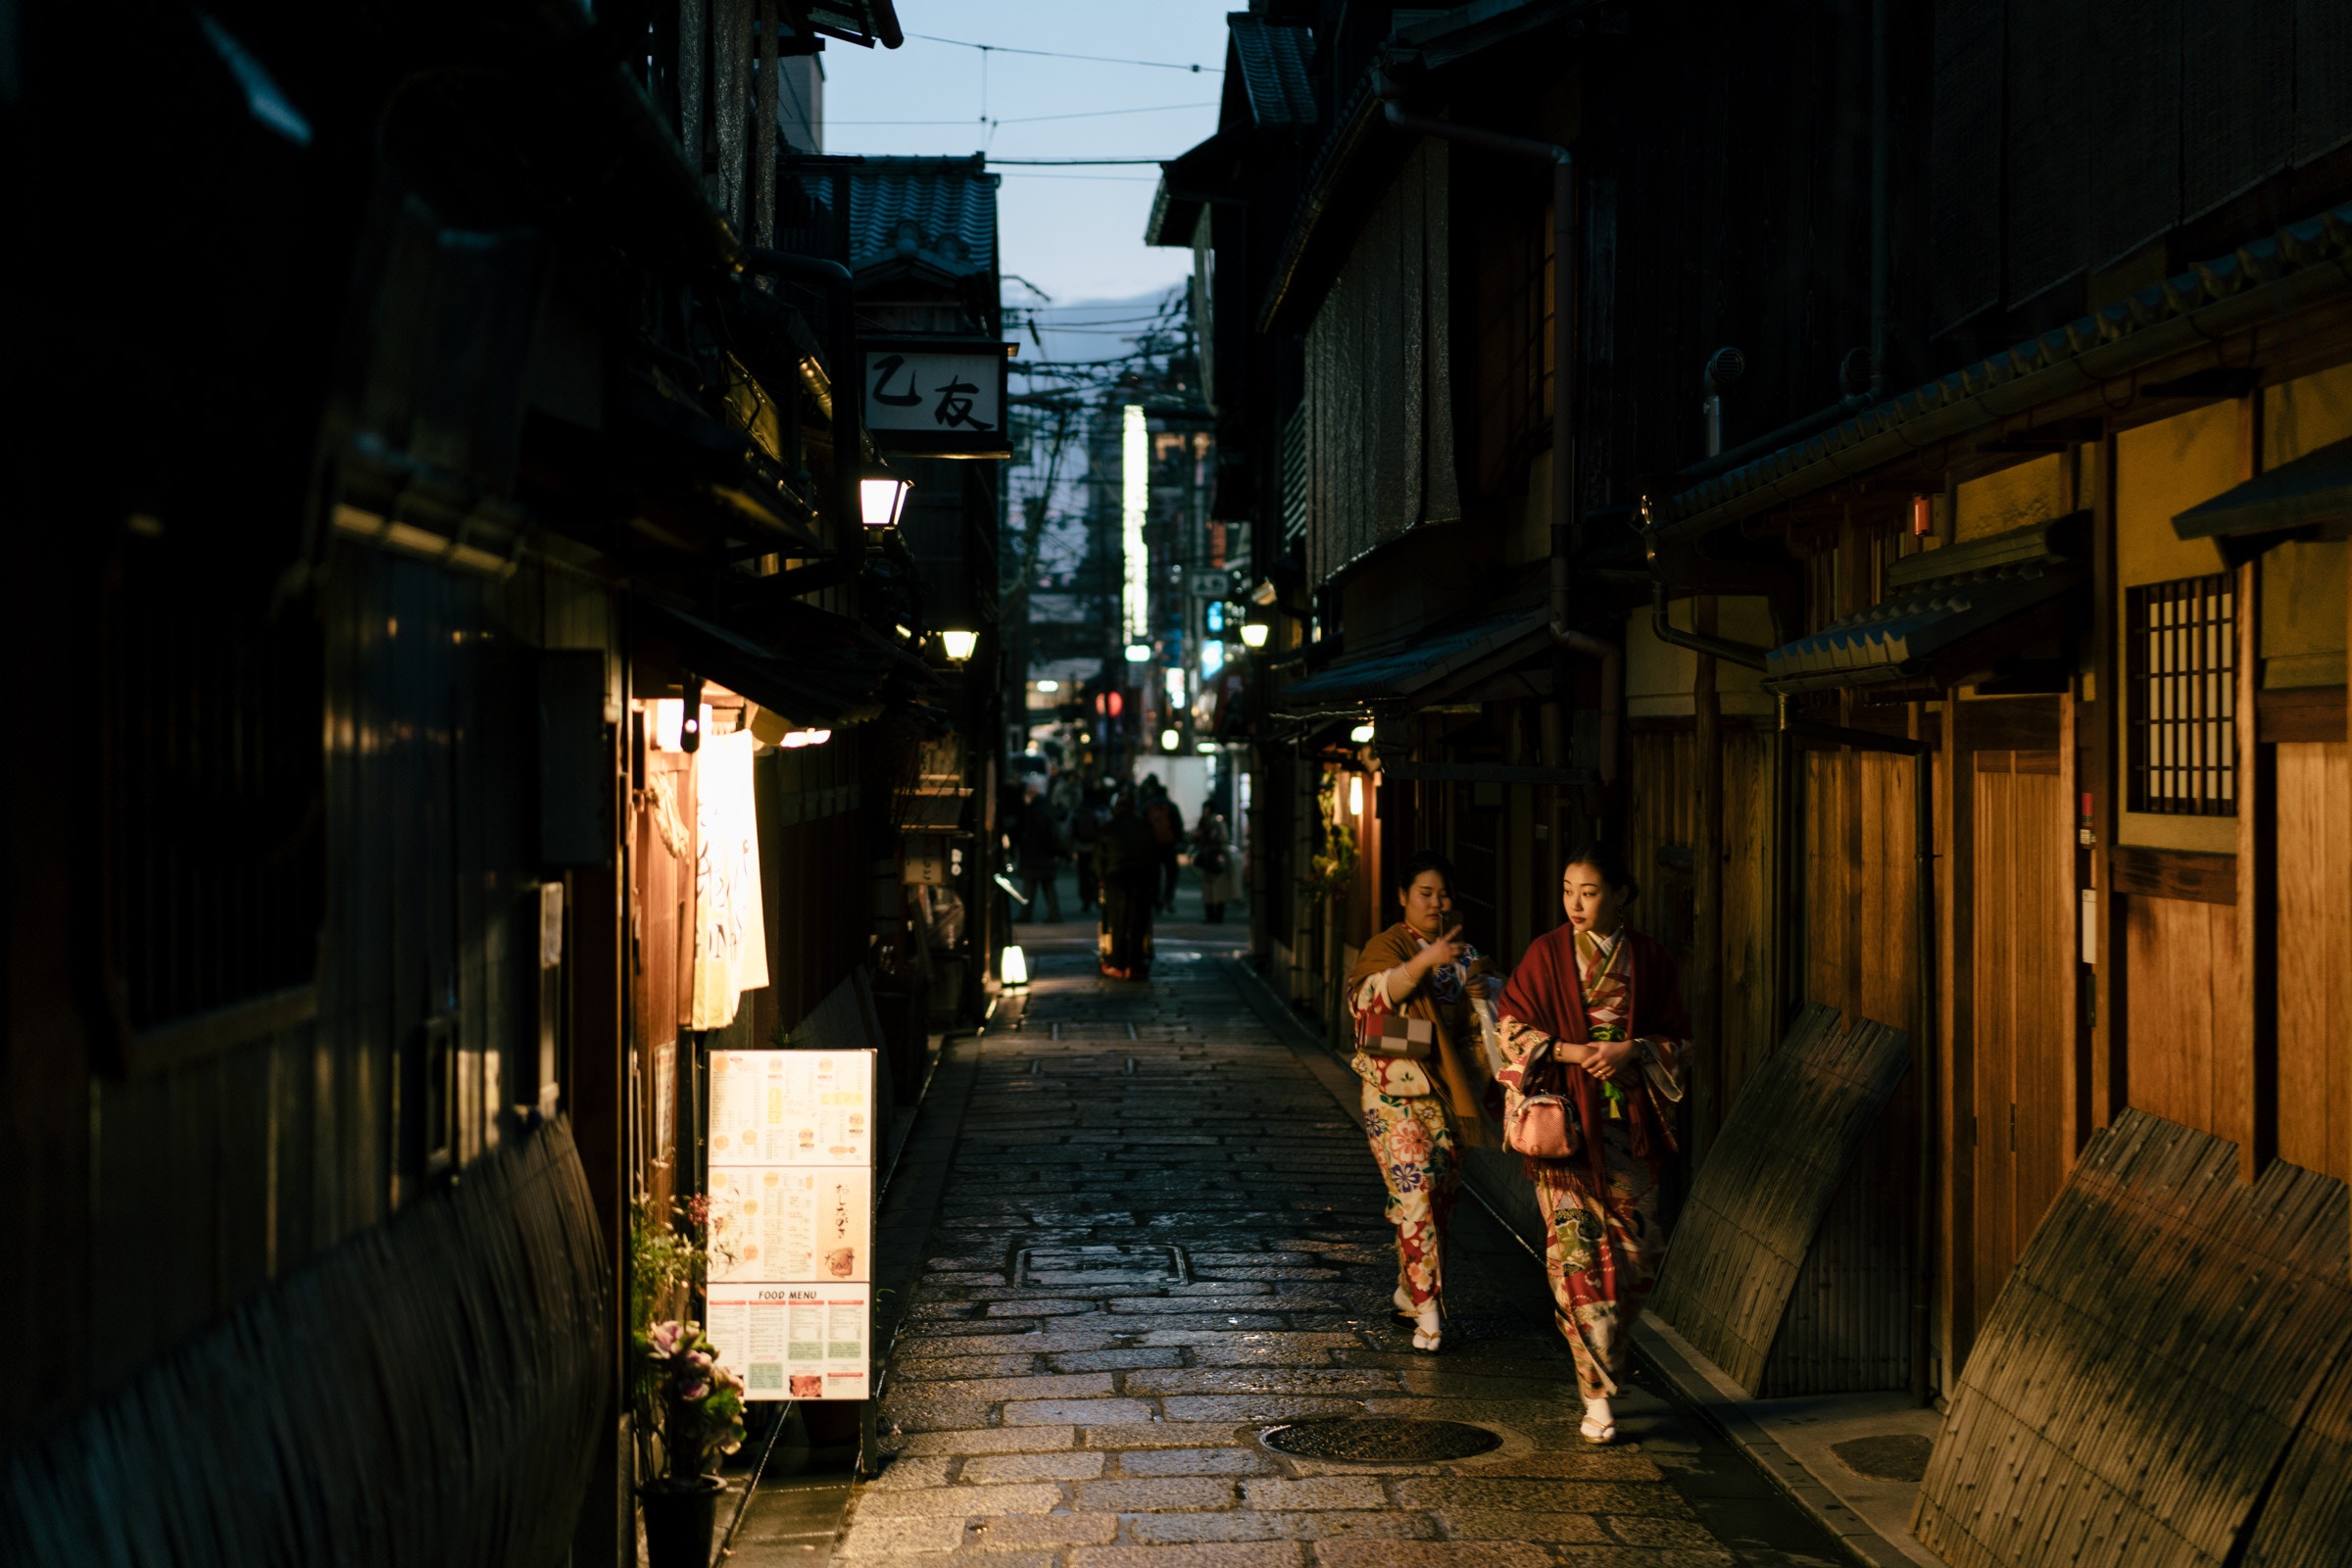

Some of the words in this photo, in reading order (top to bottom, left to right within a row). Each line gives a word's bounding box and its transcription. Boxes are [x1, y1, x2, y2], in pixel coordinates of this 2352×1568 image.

[872, 355, 995, 430] 乙友
[759, 1291, 785, 1299] FOOD
[789, 1291, 816, 1299] MENU
